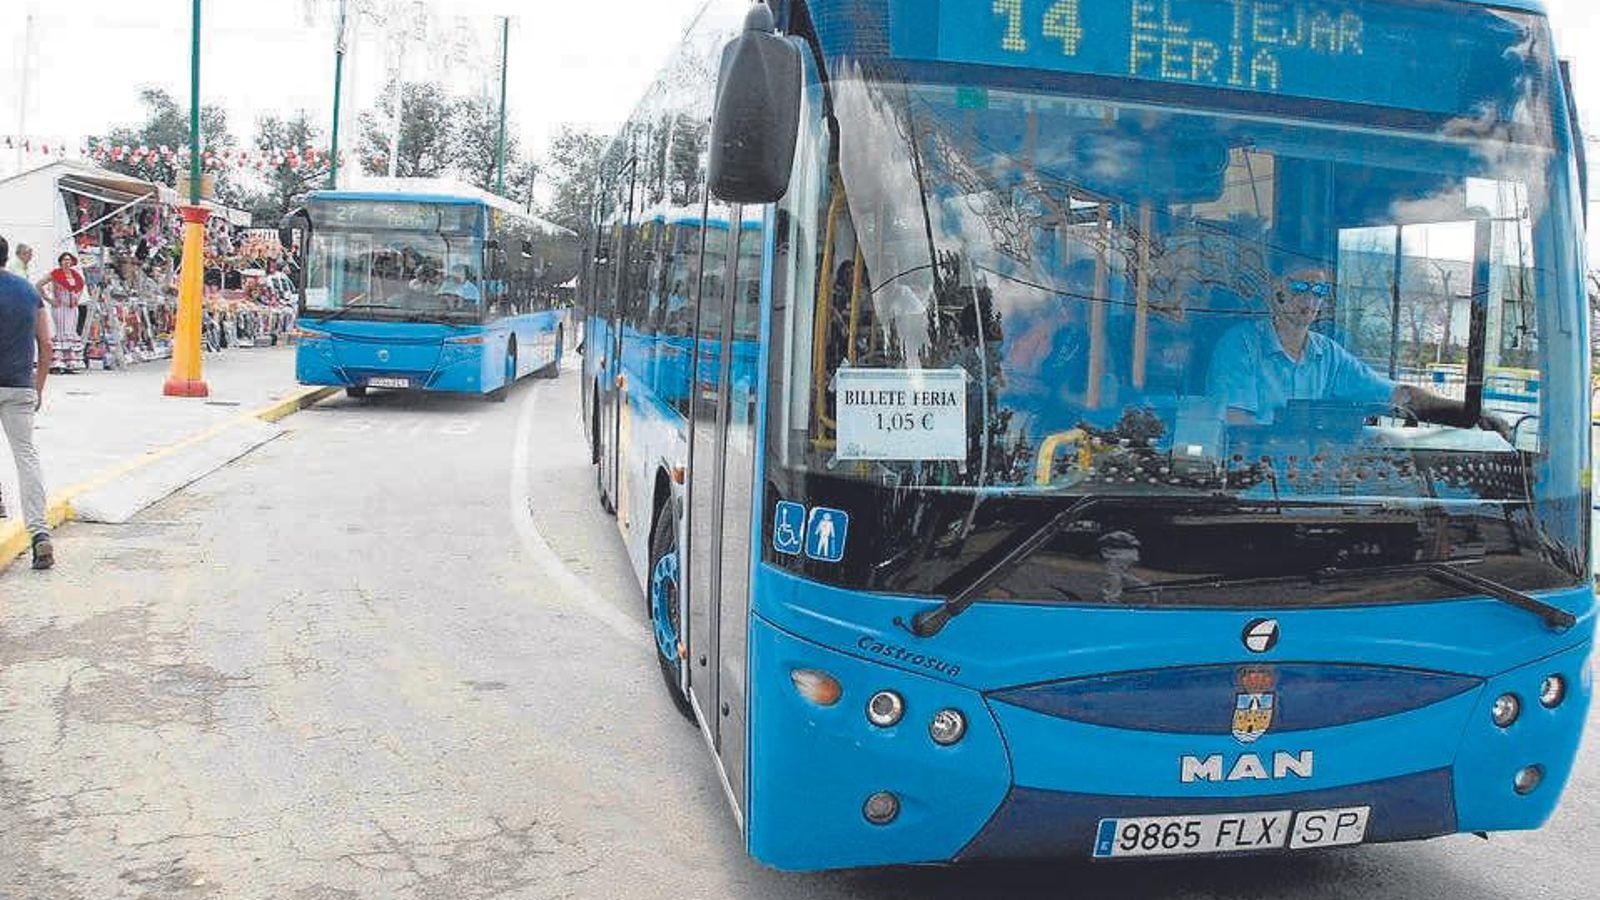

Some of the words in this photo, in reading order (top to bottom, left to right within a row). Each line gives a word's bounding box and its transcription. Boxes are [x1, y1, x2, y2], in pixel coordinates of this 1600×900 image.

[991, 0, 1083, 56] 14
[1131, 0, 1190, 33] EL
[1129, 34, 1278, 91] FERIA
[845, 390, 906, 406] BILLETE
[913, 391, 957, 407] FERIA
[877, 413, 915, 433] 1,05
[857, 635, 961, 677] Castrosua
[1180, 751, 1313, 783] MAN
[1119, 821, 1202, 850] 9865
[1215, 817, 1276, 847] FLX
